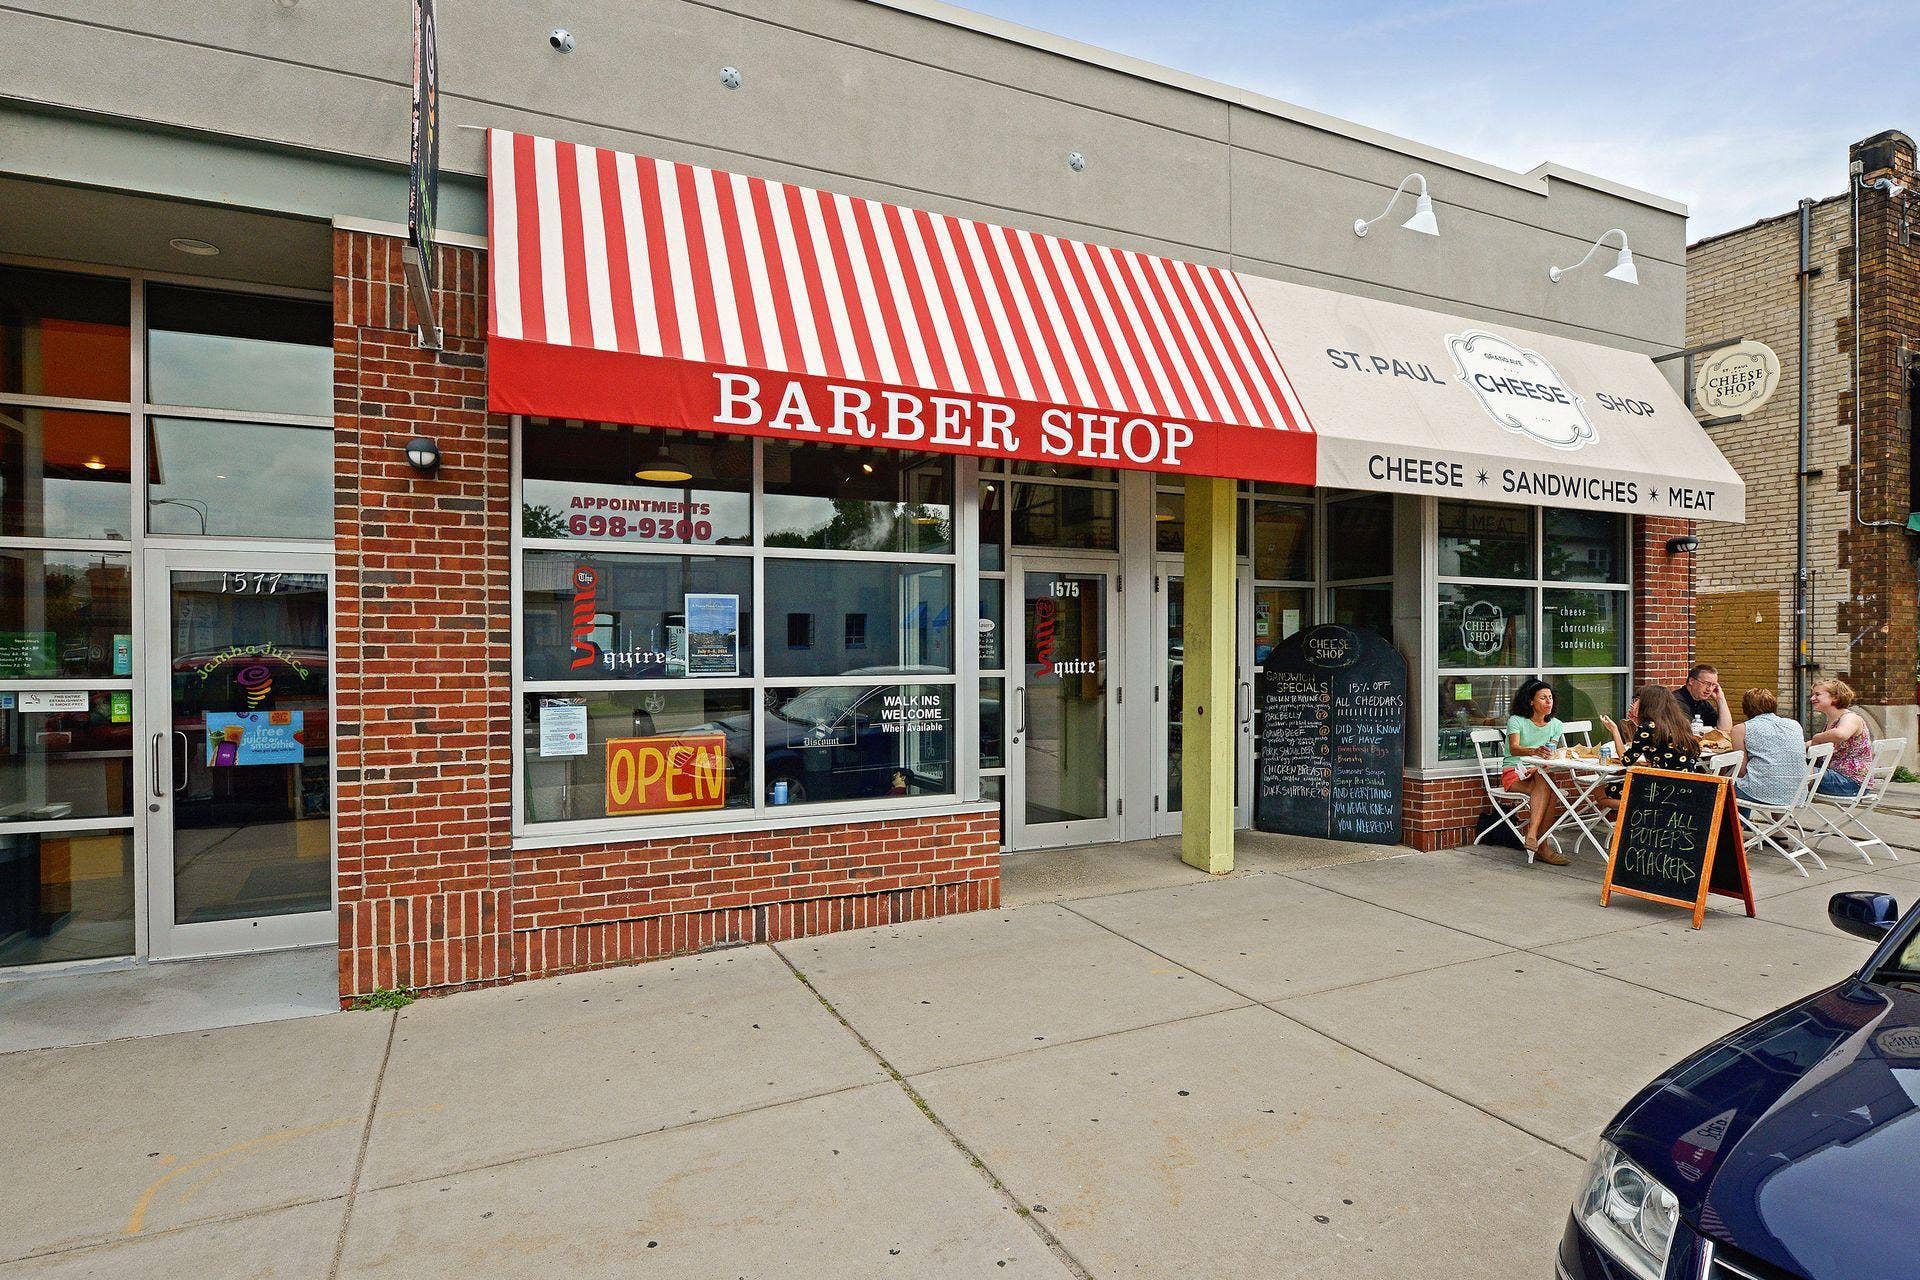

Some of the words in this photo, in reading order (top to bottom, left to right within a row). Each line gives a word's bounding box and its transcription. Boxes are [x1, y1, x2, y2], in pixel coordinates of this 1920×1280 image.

[1326, 347, 1369, 373] ST.
[1371, 355, 1446, 386] PAUL
[1709, 368, 1763, 388] CHEESE
[1474, 373, 1571, 405] CHEESE
[1716, 380, 1756, 398] SHOP
[1595, 391, 1655, 419] SHOP
[711, 371, 1020, 453] BARBER
[1039, 408, 1195, 467] SHOP
[1367, 454, 1464, 488] CHEESE
[1501, 468, 1639, 505] SANDWICHES
[1668, 486, 1716, 512] MEAT
[570, 496, 711, 516] APPOINTMENTS
[568, 514, 713, 541] 698-9300
[220, 571, 283, 595] 1577
[1048, 581, 1080, 598] 1575
[1560, 605, 1586, 617] cheese
[1560, 621, 1606, 633] charcuterie
[1470, 631, 1496, 642] SHOP
[1309, 638, 1350, 651] CHEESE
[1560, 638, 1605, 649] sandwiches
[1315, 649, 1345, 660] SHOP
[1276, 682, 1329, 694] SPECIALS
[1349, 681, 1370, 693] 15%
[1372, 681, 1391, 691] OFF
[883, 696, 918, 707] WALK
[921, 695, 941, 706] INS
[1335, 696, 1350, 708] ALL
[1355, 694, 1404, 707] CHEDDARS
[881, 708, 942, 720] WELCOME
[256, 724, 284, 737] free
[882, 723, 904, 733] When
[907, 722, 943, 732] Available
[1335, 723, 1352, 735] DID
[1356, 723, 1373, 735] YOU
[1376, 723, 1401, 735] KNOW
[249, 739, 295, 751] smoothie
[804, 737, 840, 746] Discount
[1341, 735, 1355, 745] WE
[1358, 736, 1384, 745] HAVE
[610, 744, 724, 806] OPEN
[1263, 764, 1296, 776] CHICKEN
[1332, 786, 1349, 799] AND
[1644, 782, 1693, 807] $2.00
[1346, 801, 1369, 816] NEVER
[1369, 802, 1394, 816] KNEW
[1630, 809, 1663, 827] OFF
[1666, 811, 1698, 831] ALL
[1625, 846, 1696, 884] CRACKERS
